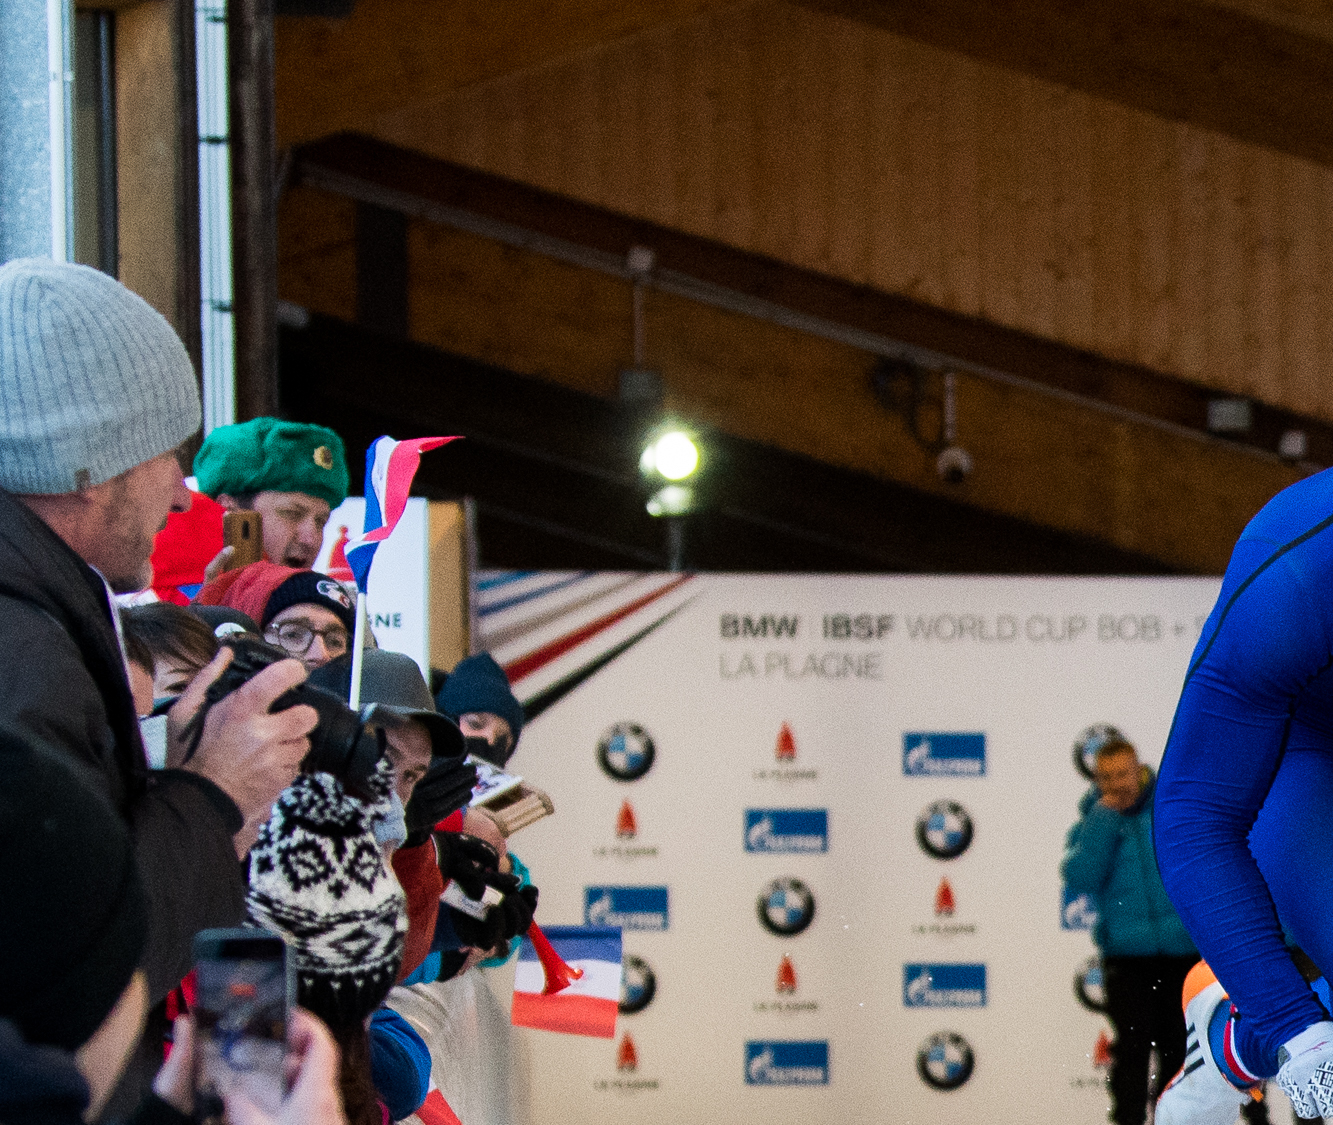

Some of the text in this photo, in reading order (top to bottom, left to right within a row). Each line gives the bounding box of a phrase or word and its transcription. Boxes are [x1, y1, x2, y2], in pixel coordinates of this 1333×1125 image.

[719, 612, 799, 640] BMW
[821, 612, 896, 640] IBSF
[902, 612, 1017, 641] WORLD
[1024, 612, 1087, 641] CUP
[1096, 612, 1162, 641] BOB
[718, 650, 884, 681] LA PLAGNE
